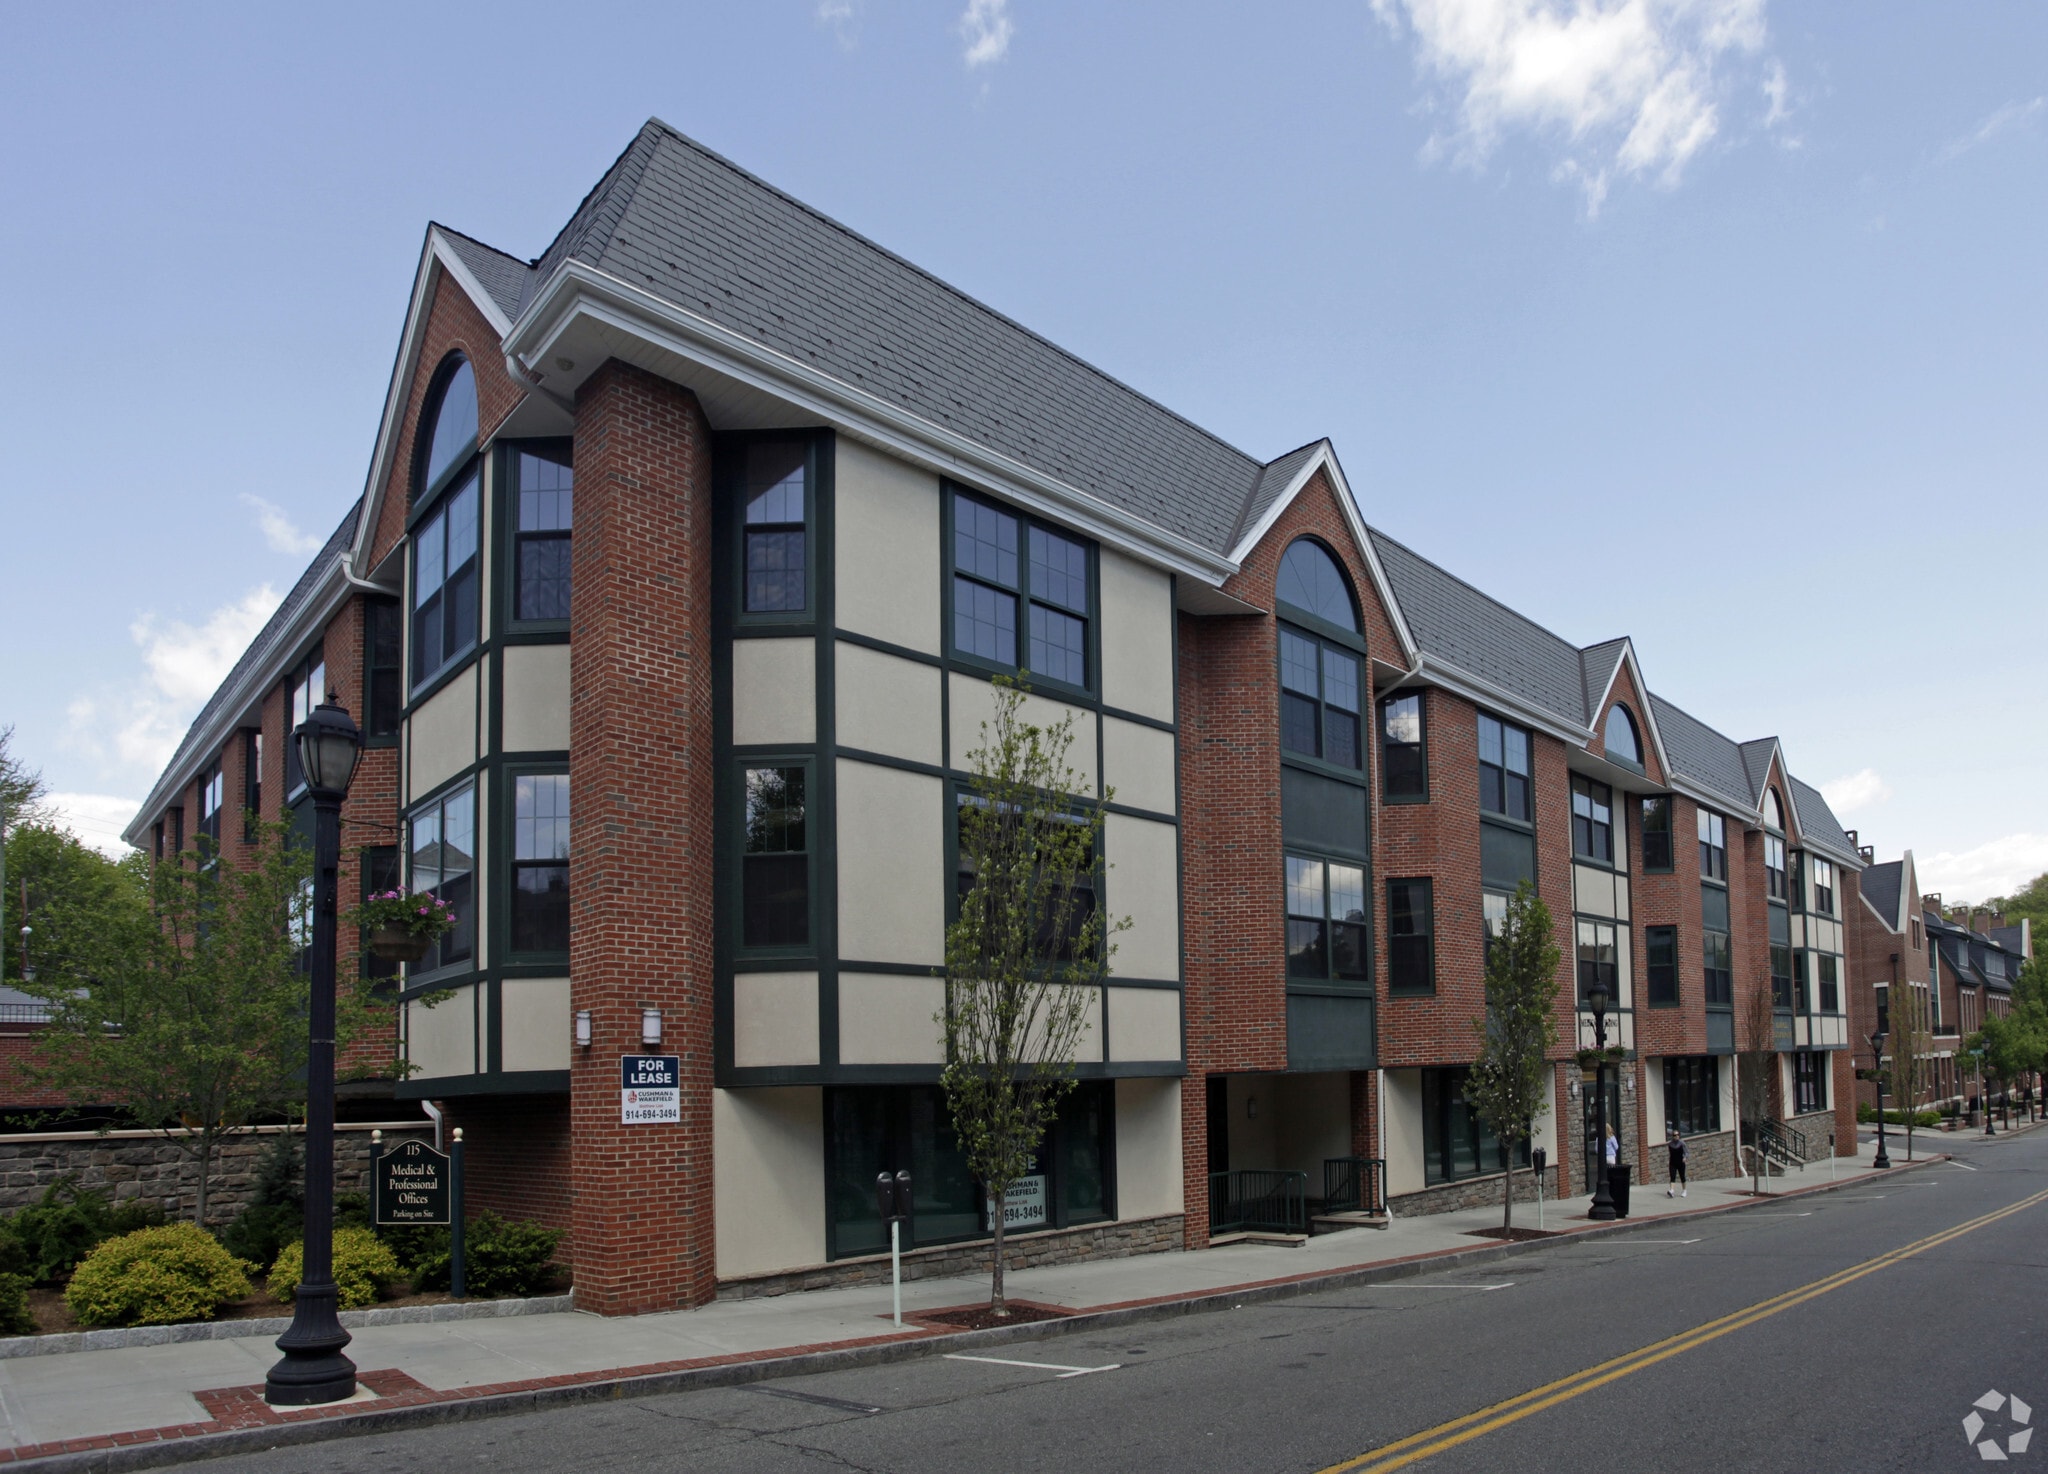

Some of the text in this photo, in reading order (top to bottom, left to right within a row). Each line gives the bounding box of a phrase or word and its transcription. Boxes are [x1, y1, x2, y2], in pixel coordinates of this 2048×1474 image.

[638, 1060, 664, 1071] FOR
[630, 1072, 672, 1084] LEASE
[625, 1109, 677, 1120] 914-694-3494
[406, 1144, 421, 1156] 115
[391, 1163, 435, 1176] Medical &
[389, 1177, 438, 1190] Professional
[398, 1192, 429, 1204] Offices
[1005, 1187, 1038, 1198] AKEFIELD
[393, 1209, 414, 1219] Parking
[423, 1209, 434, 1217] Site
